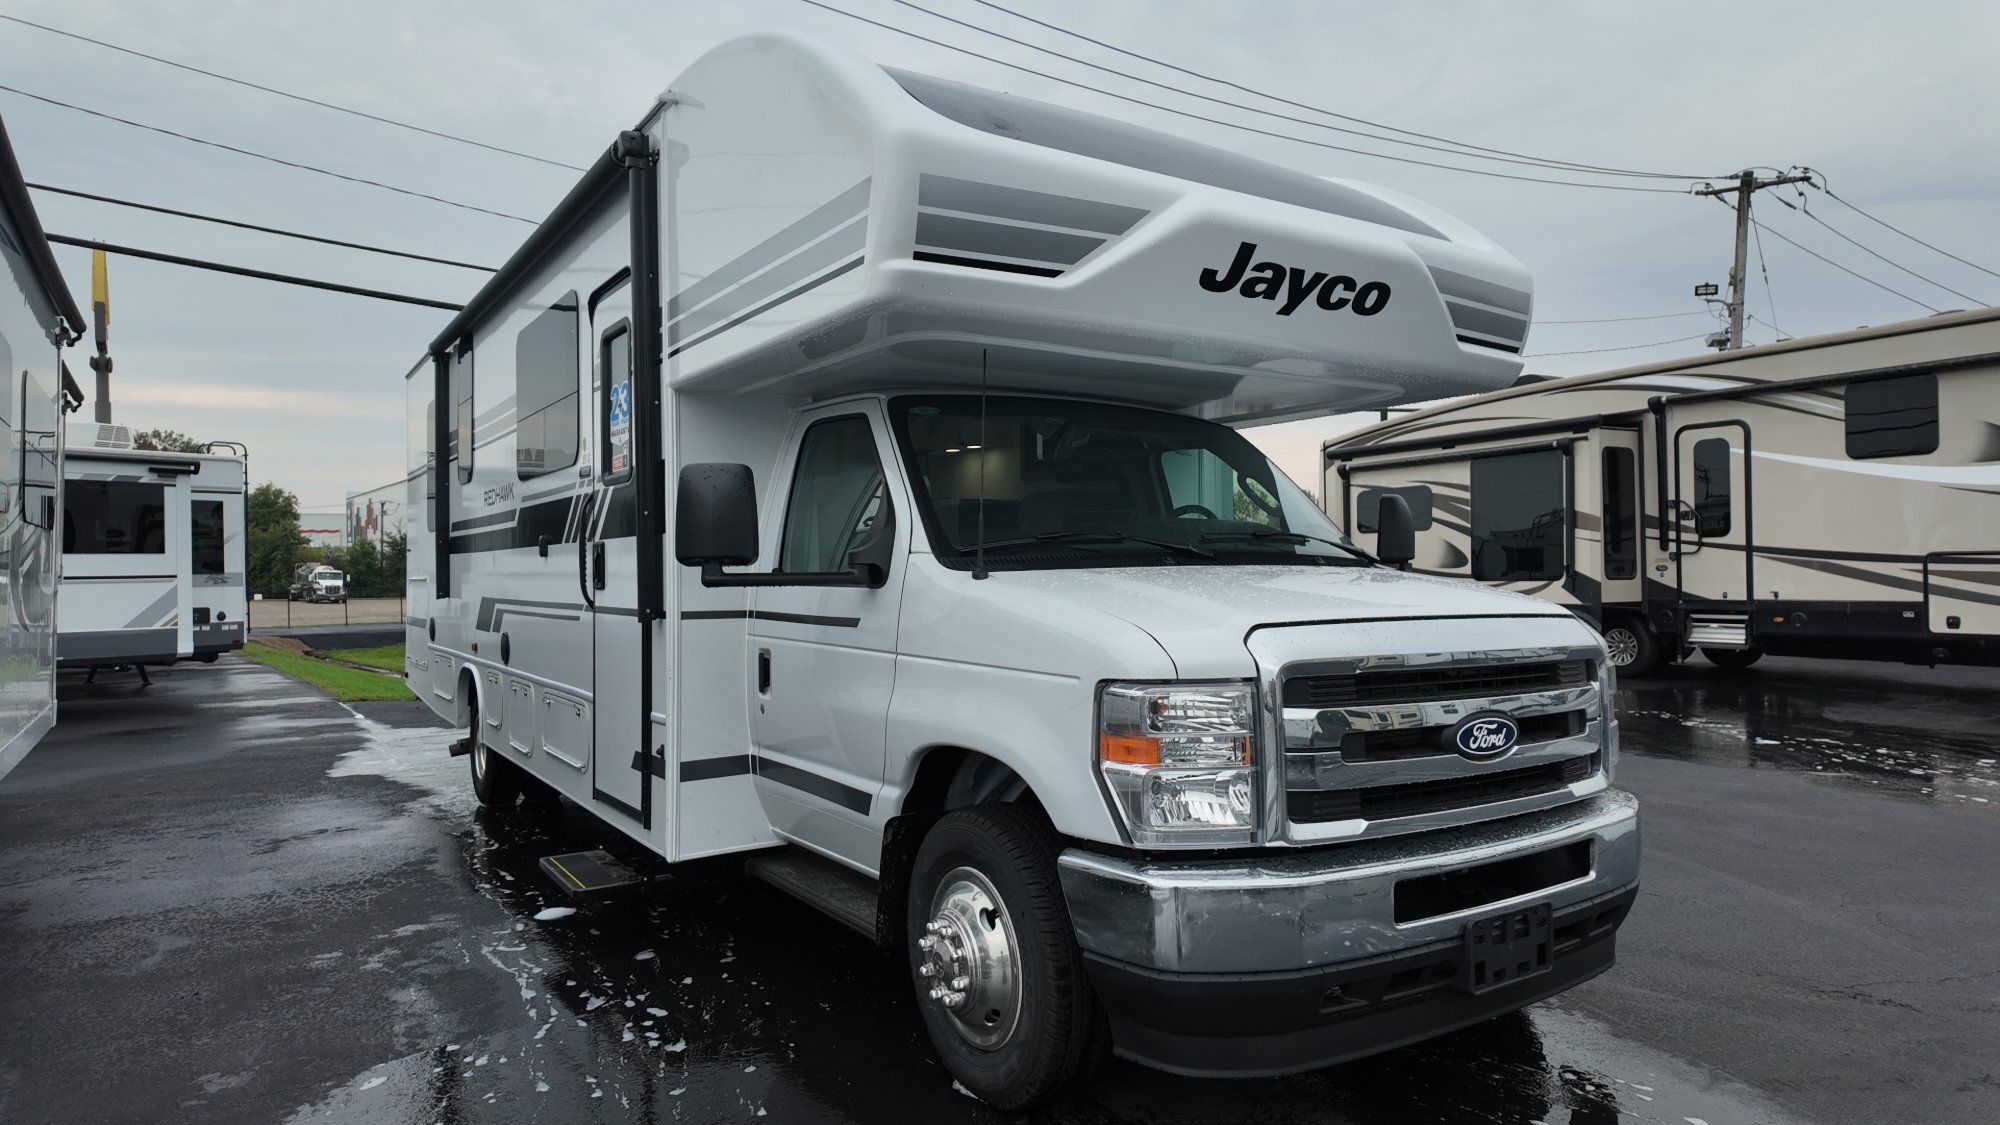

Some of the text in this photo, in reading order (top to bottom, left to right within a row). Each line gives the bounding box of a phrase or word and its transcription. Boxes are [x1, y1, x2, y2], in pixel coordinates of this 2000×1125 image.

[1199, 241, 1391, 316] Jayco
[484, 483, 515, 507] REDHAWK
[1469, 723, 1507, 749] Ford
